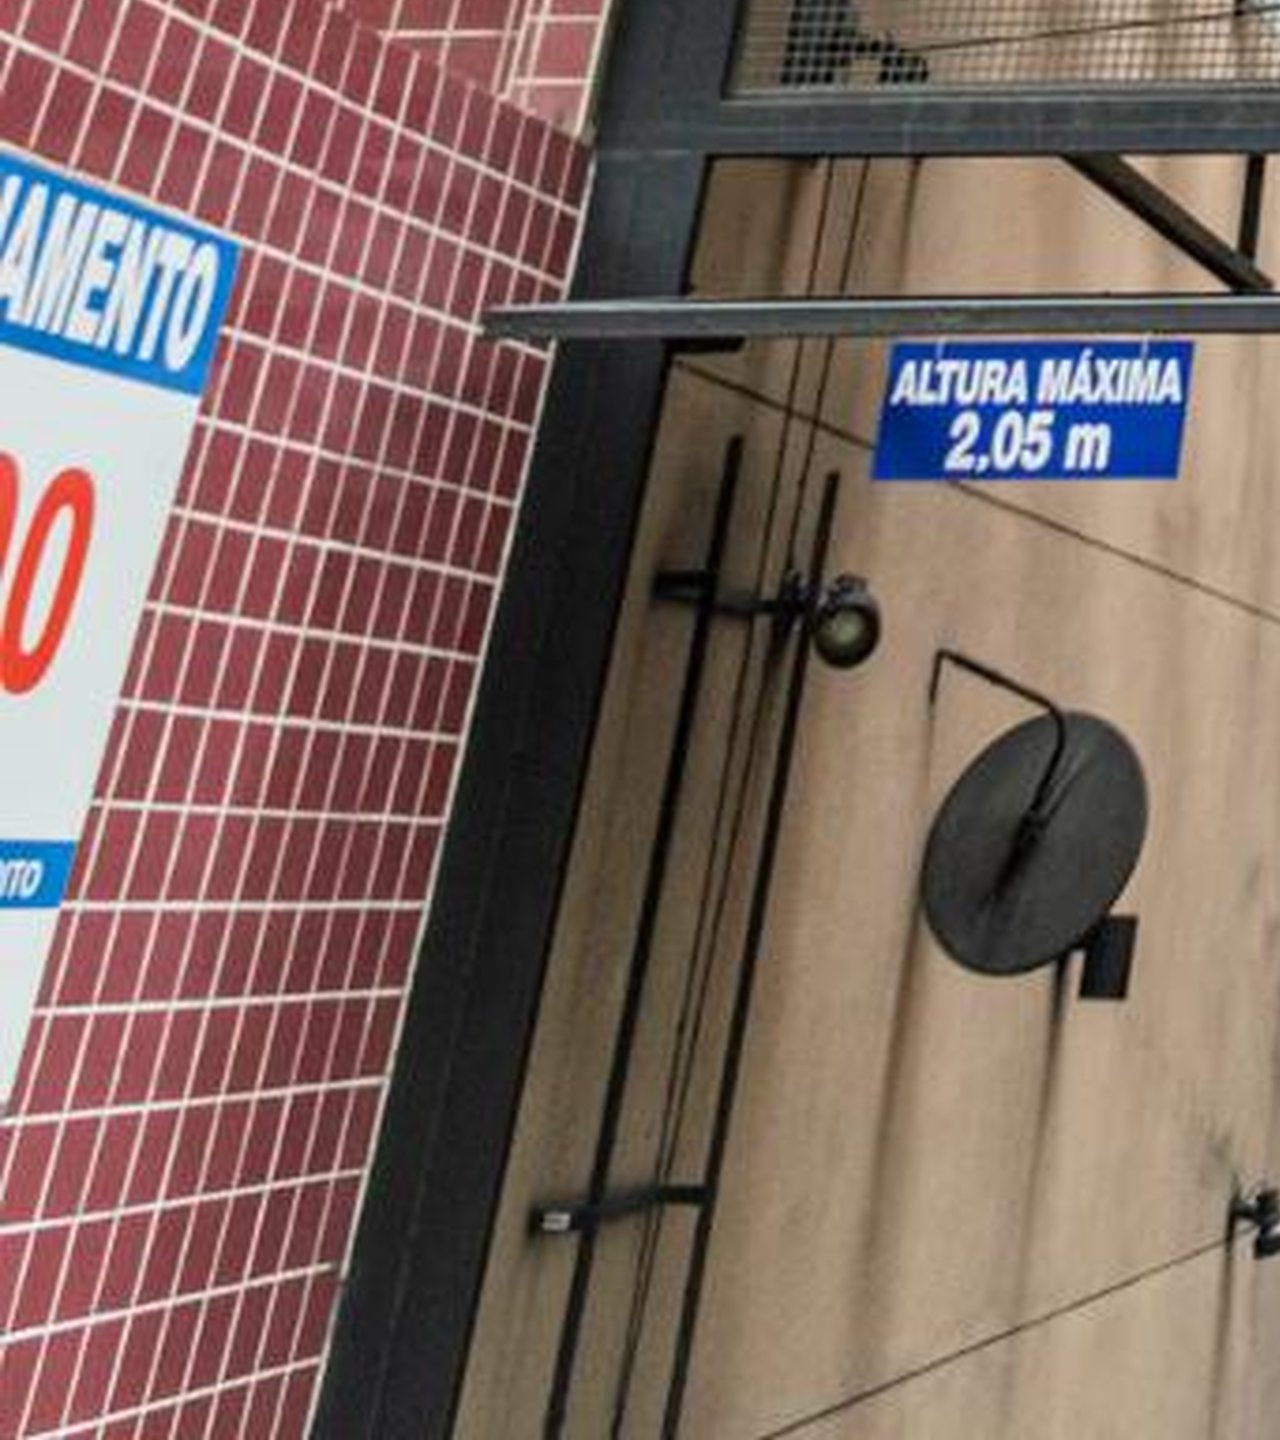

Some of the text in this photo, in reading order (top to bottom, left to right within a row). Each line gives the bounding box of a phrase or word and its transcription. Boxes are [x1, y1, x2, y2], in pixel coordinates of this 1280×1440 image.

[890, 348, 1182, 405] ALTURA MÁXIMA
[944, 411, 1111, 472] 2,05 m
